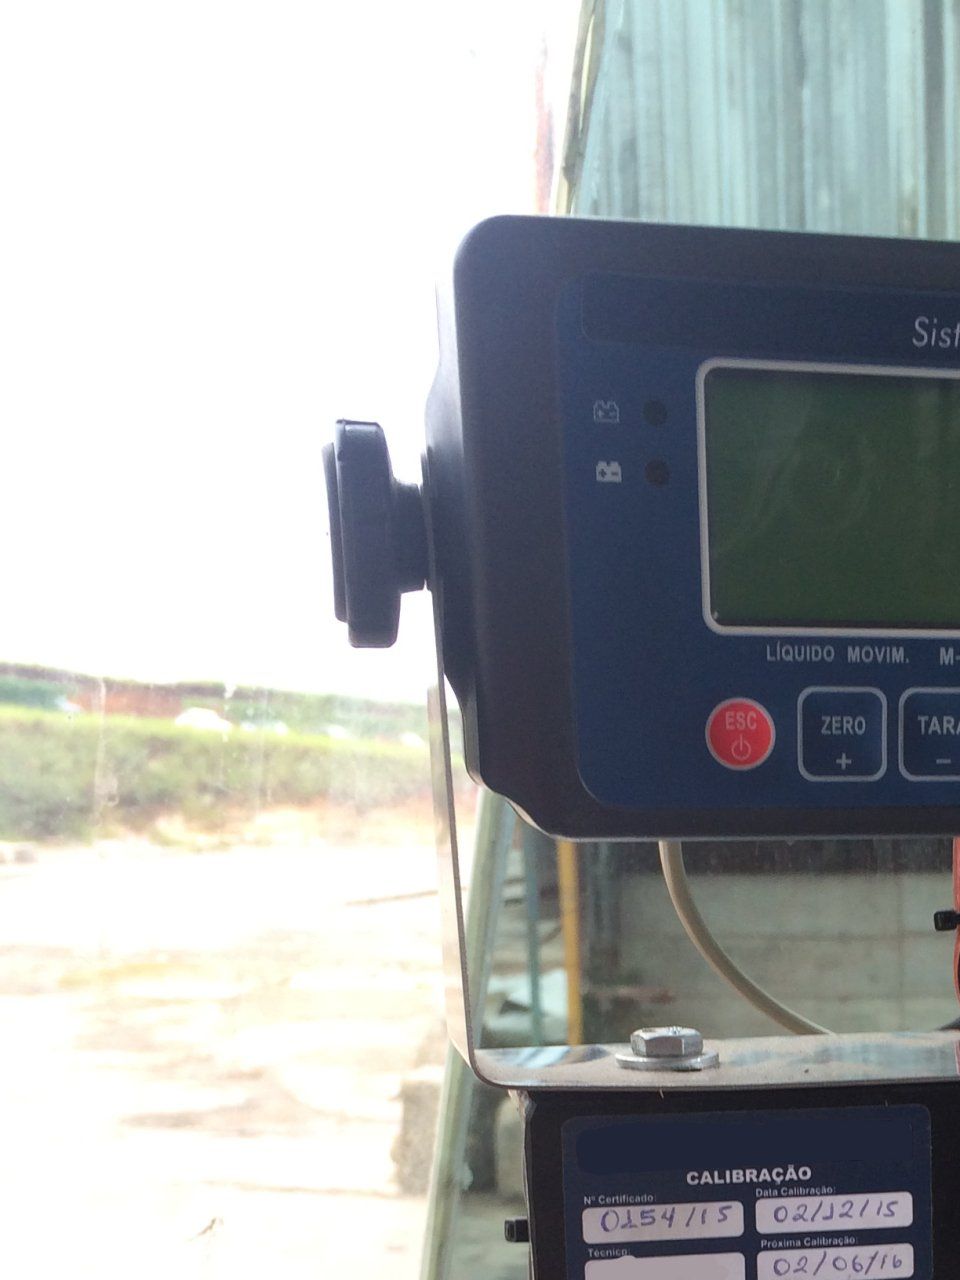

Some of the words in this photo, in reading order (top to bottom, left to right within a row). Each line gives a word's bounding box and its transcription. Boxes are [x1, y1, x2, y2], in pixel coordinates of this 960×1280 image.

[766, 640, 835, 662] LÍQUIDO
[847, 645, 910, 665] MOVIM.
[725, 711, 757, 730] ESC
[820, 715, 866, 736] ZERO
[686, 1164, 812, 1186] CALIBRAÇÃO
[755, 1187, 778, 1198] Data
[780, 1184, 836, 1197] Calibração:
[760, 1238, 801, 1249] Próxima
[773, 1250, 903, 1277] 02/06/16
